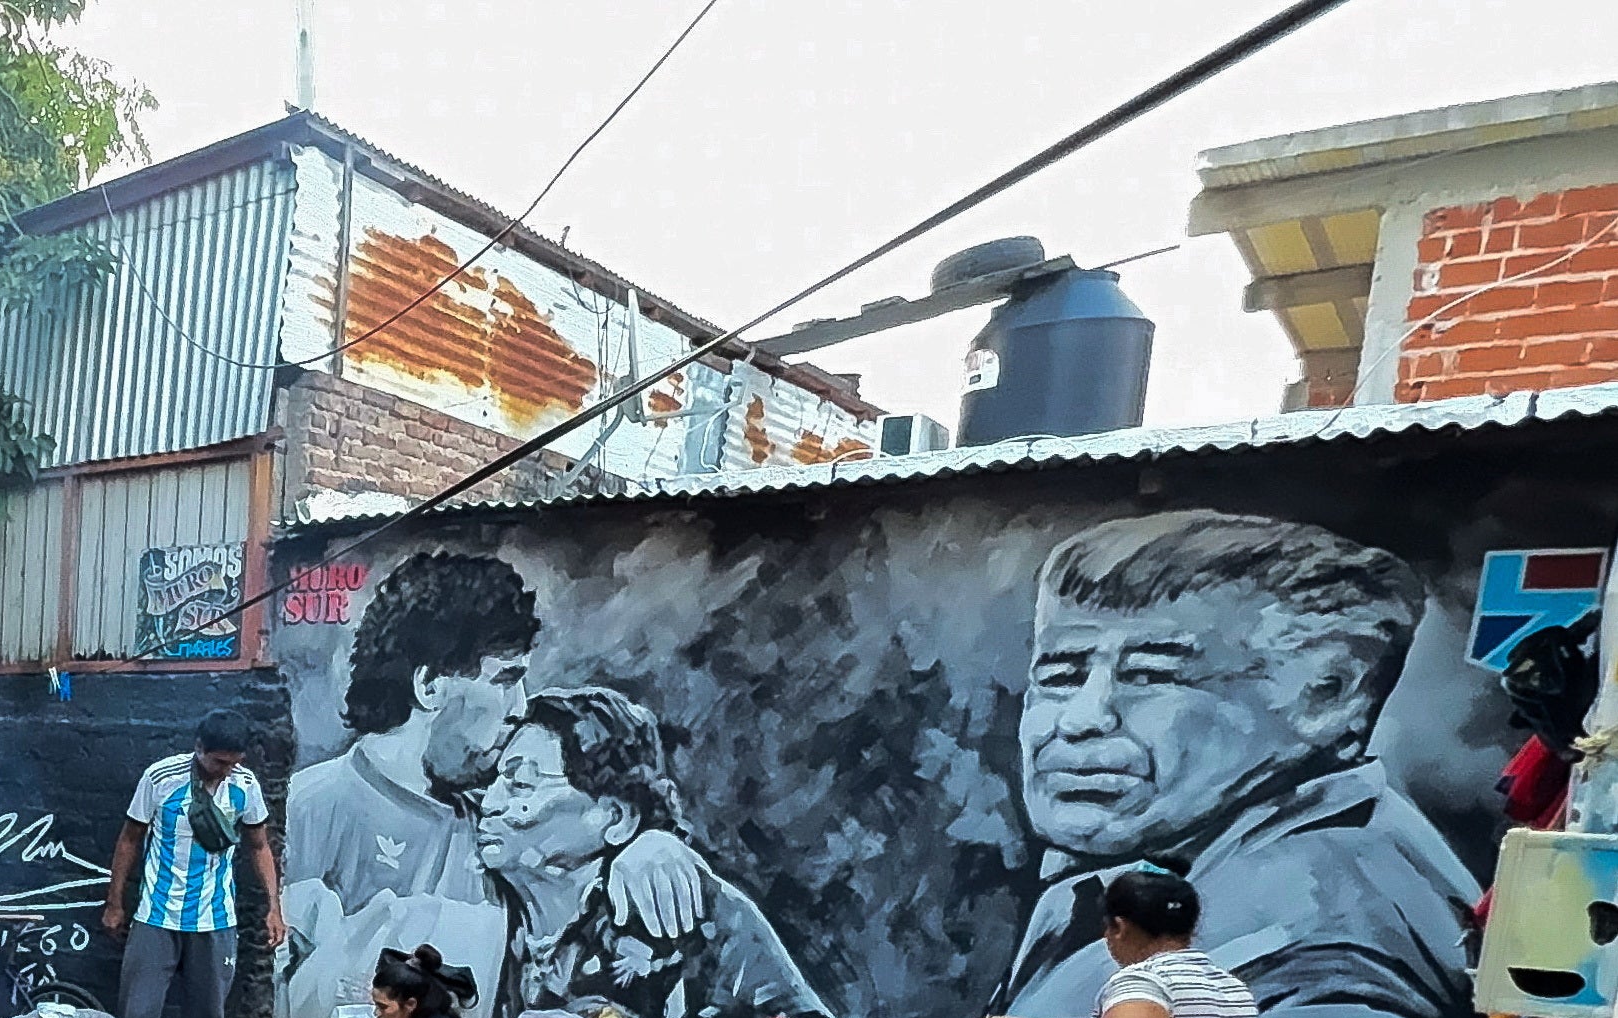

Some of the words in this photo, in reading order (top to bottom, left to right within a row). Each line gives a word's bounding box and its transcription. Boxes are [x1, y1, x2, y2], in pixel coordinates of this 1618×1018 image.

[164, 547, 243, 580] SOMOS
[286, 563, 366, 592] MURO
[151, 565, 214, 611] MURO
[180, 604, 229, 634] SUR
[283, 592, 350, 625] SUR
